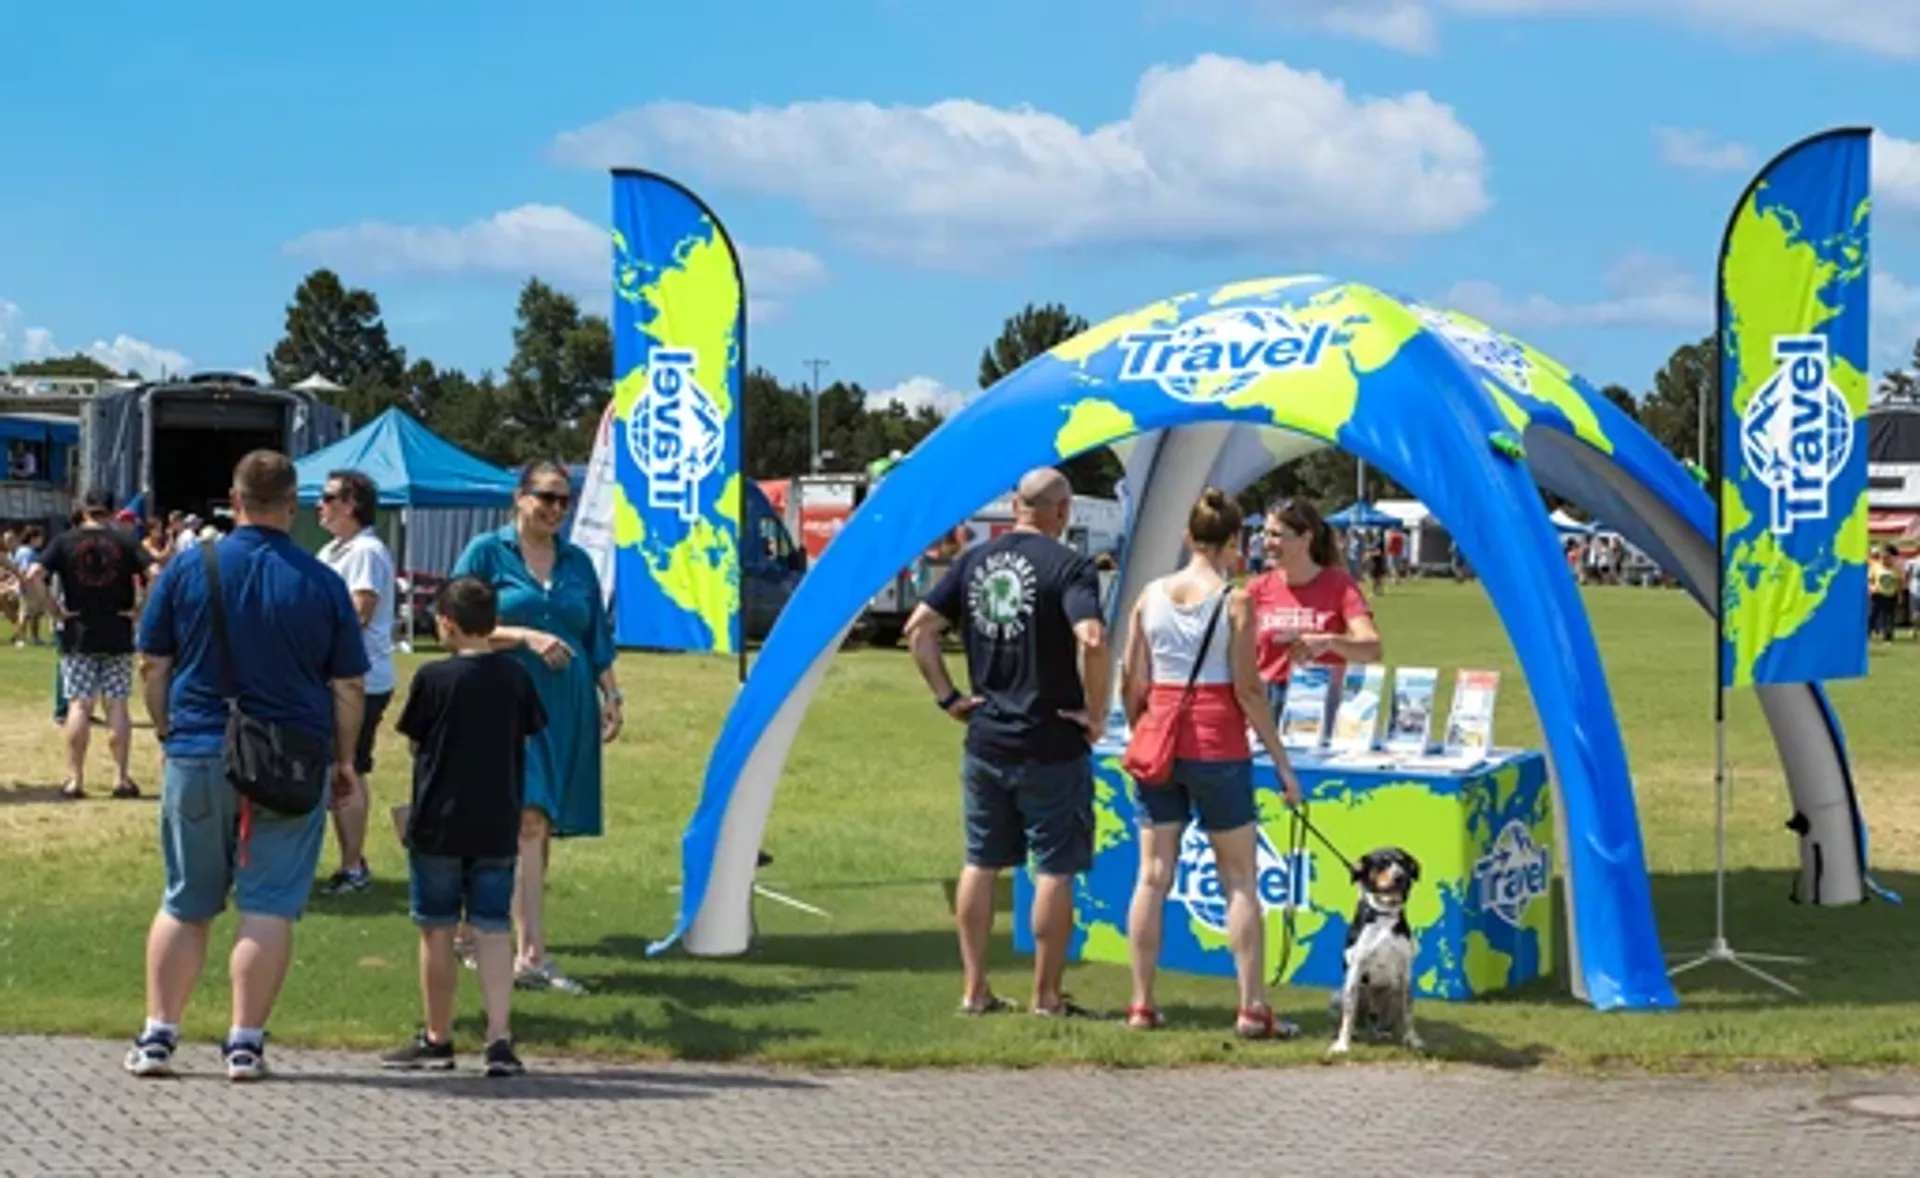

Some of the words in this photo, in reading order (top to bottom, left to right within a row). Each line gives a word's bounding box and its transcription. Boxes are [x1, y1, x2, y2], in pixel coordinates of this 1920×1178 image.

[1124, 322, 1331, 377] Travel
[1776, 338, 1825, 530] Travel
[1176, 853, 1303, 906] rael
[1477, 848, 1547, 902] Travel
